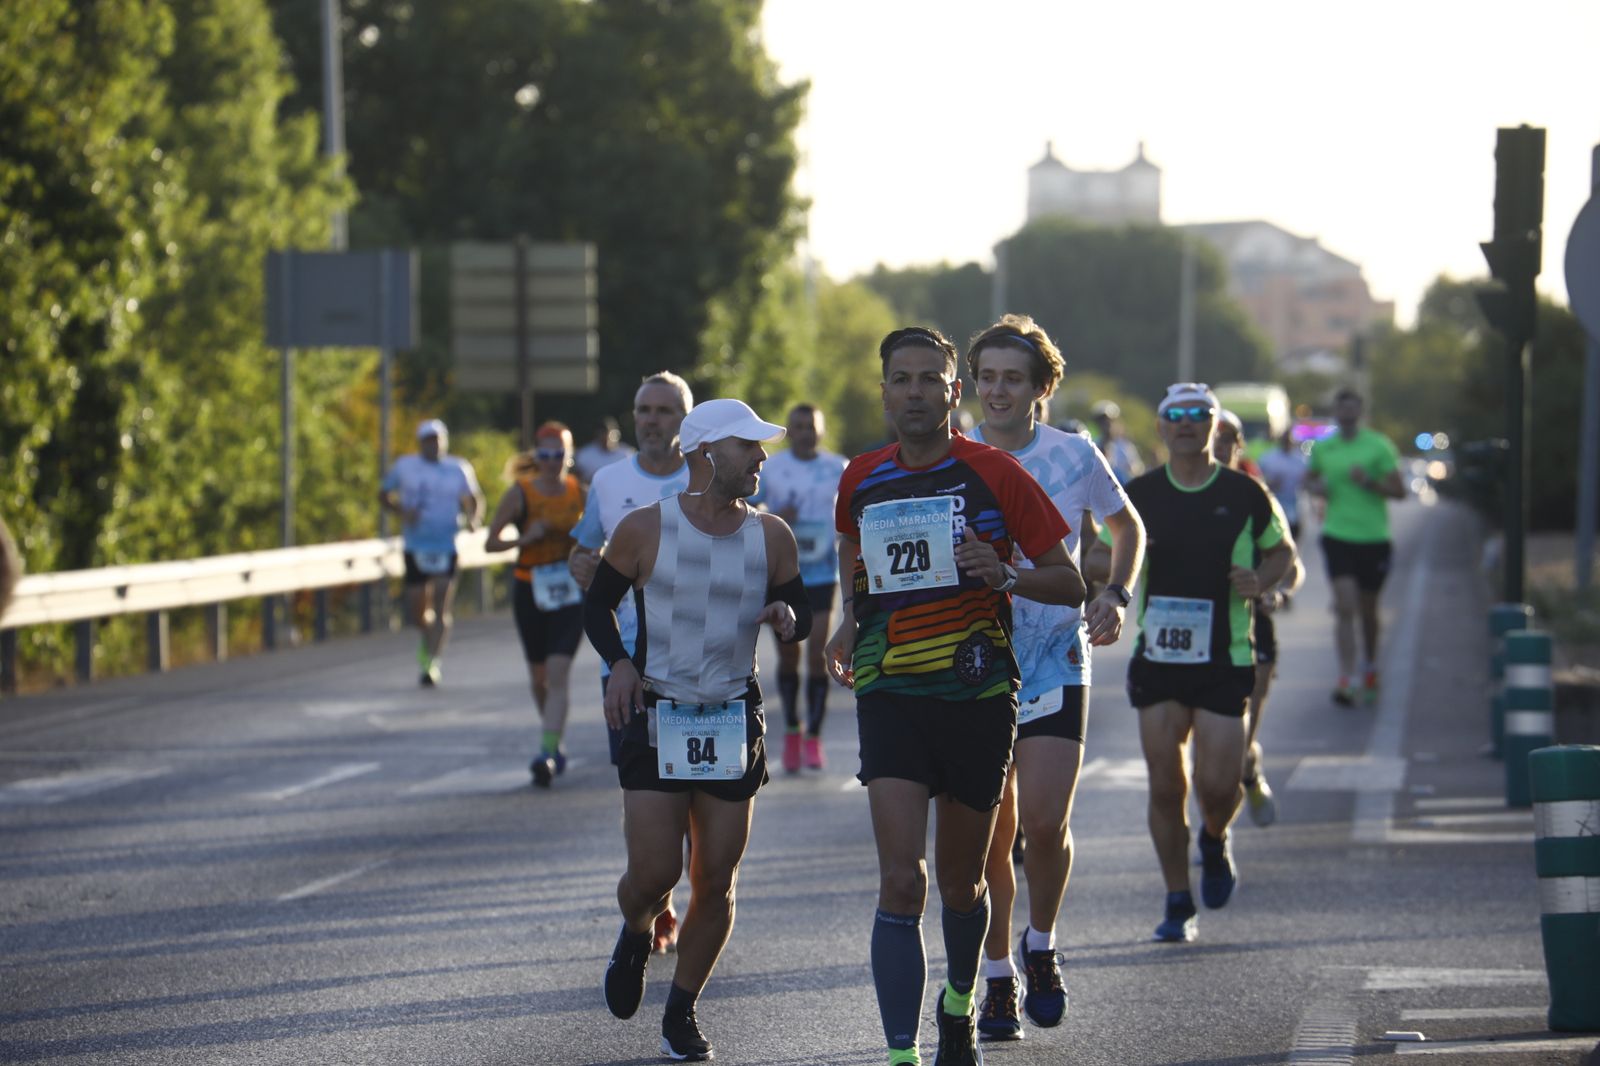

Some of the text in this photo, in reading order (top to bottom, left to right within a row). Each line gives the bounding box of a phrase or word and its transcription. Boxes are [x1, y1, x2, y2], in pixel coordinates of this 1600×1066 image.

[865, 519, 895, 531] MEDIA
[898, 511, 948, 527] MARATÓN
[886, 539, 931, 576] 229
[1156, 628, 1192, 651] 488
[661, 713, 742, 725] MEDIA MARATÓN
[686, 737, 718, 765] 84
